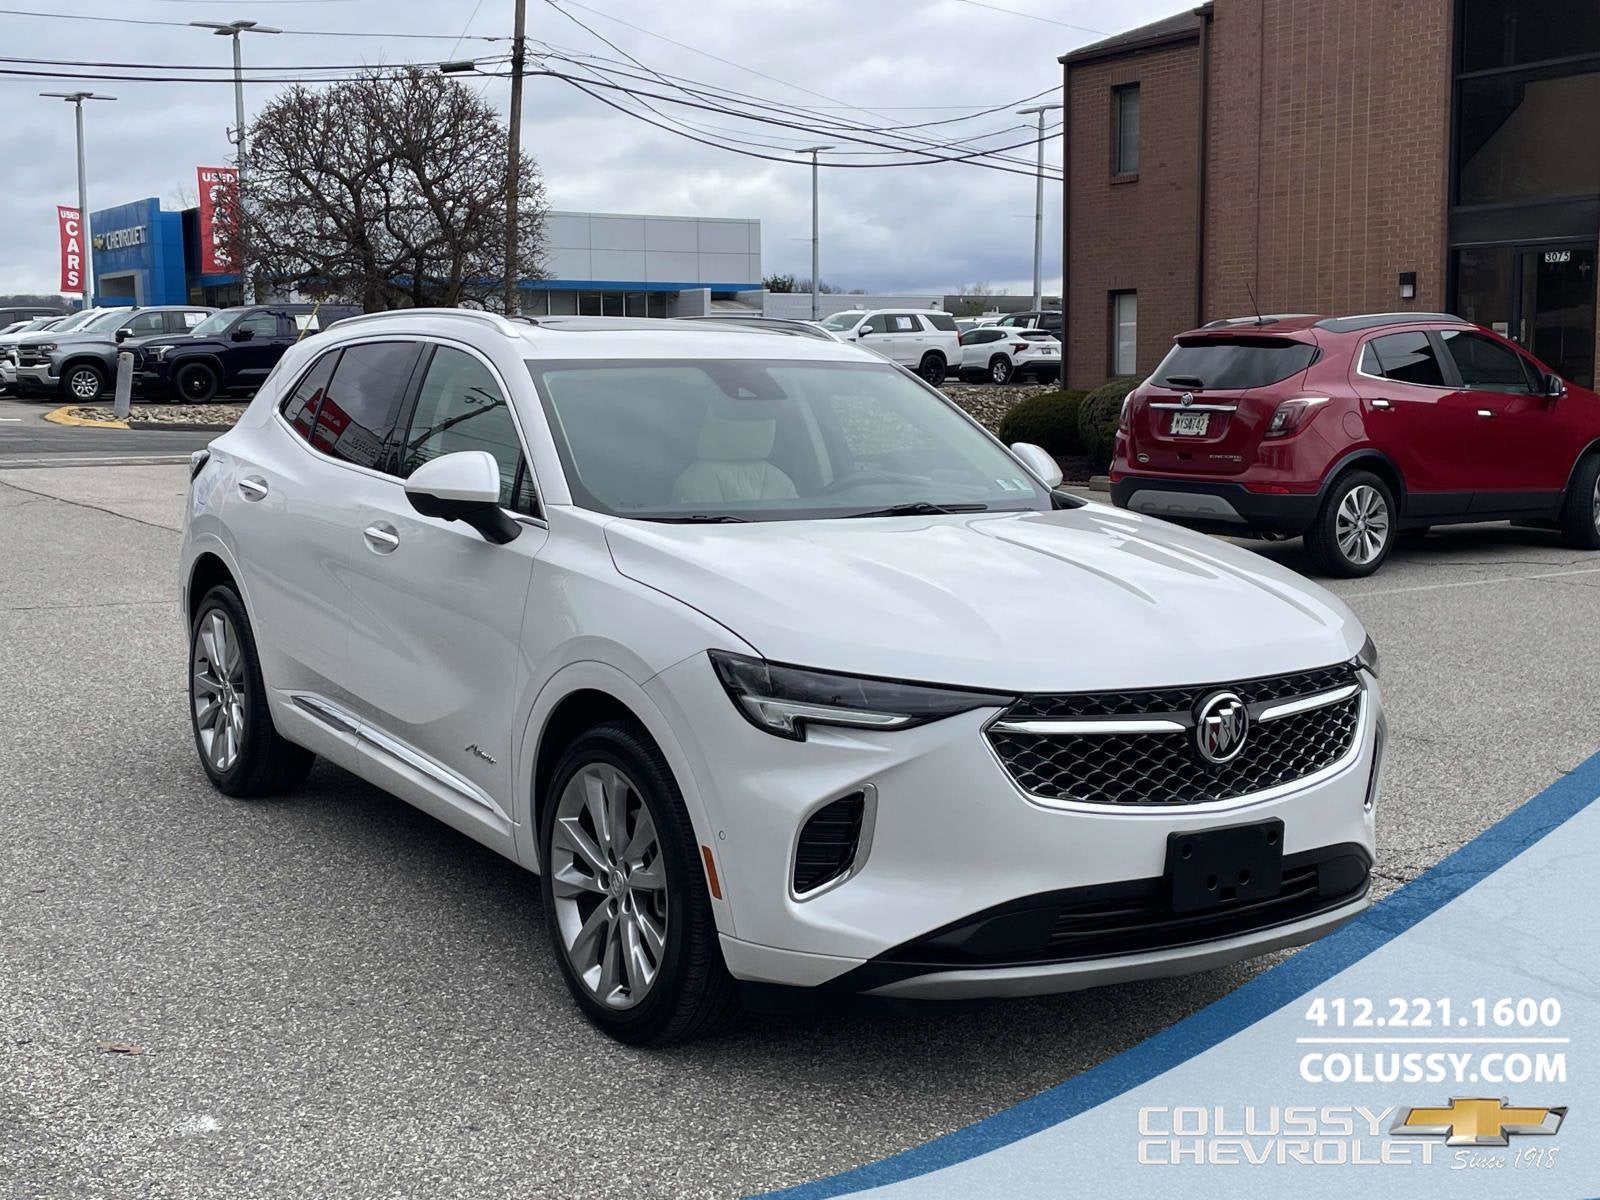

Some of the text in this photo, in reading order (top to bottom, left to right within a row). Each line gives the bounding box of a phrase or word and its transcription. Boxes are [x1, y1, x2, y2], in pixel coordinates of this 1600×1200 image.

[60, 209, 80, 219] USED
[106, 226, 145, 250] CHEVROLET
[65, 220, 80, 286] CARS
[1545, 251, 1570, 262] 3075
